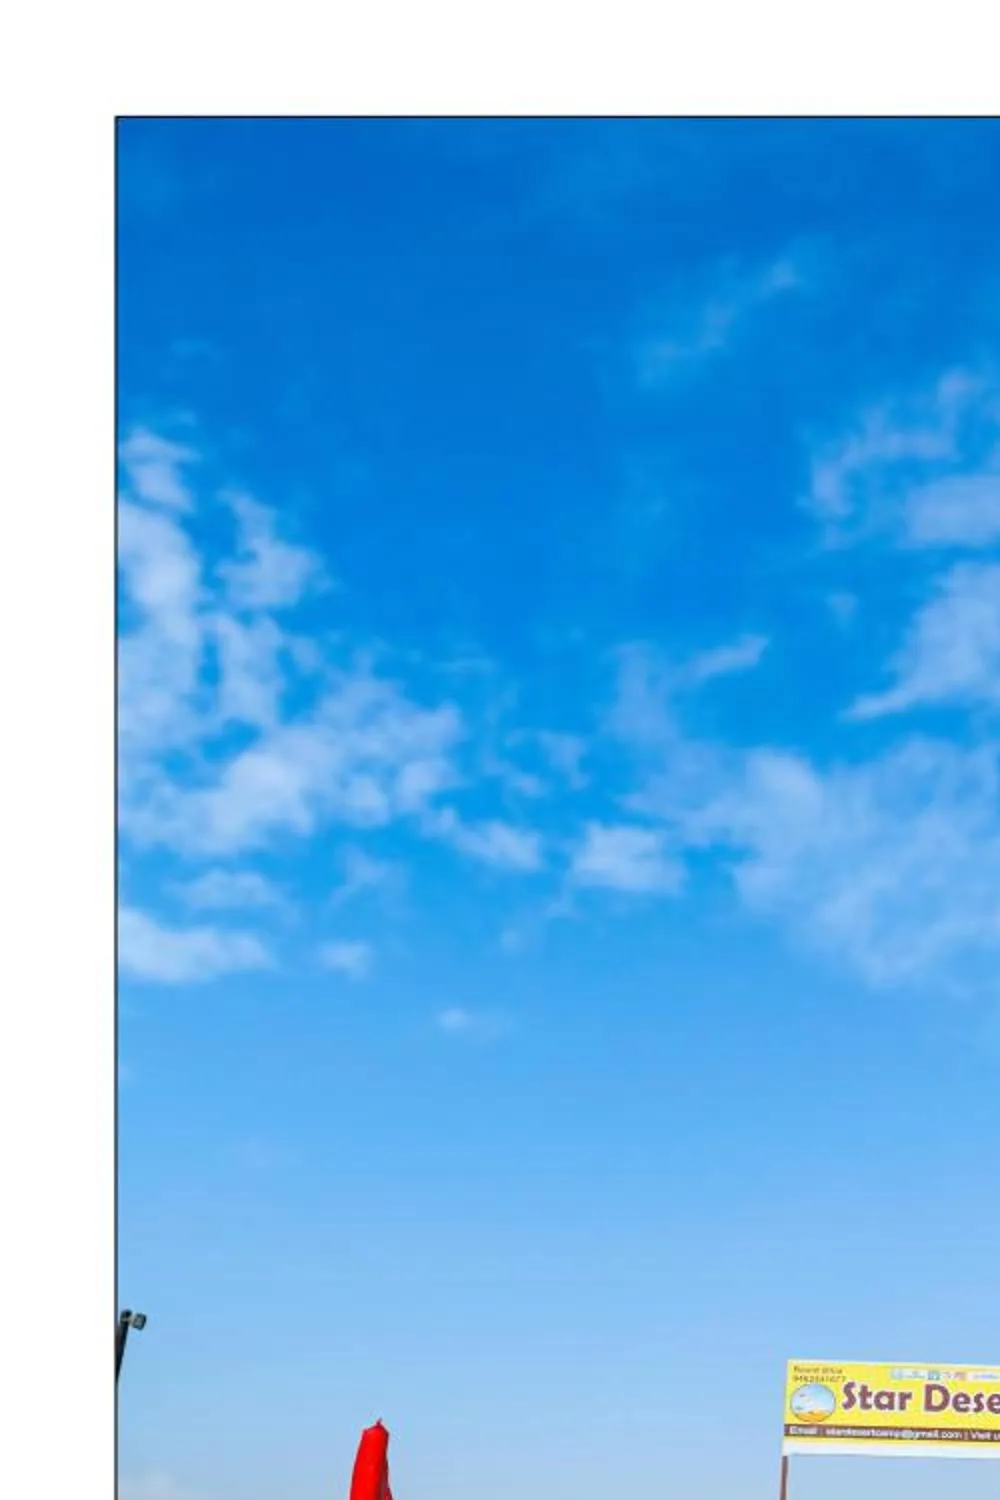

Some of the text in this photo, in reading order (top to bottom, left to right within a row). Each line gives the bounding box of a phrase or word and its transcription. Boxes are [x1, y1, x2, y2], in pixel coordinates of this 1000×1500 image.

[841, 1381, 913, 1411] Star
[789, 1425, 818, 1435] Email
[970, 1431, 991, 1440] Visit
